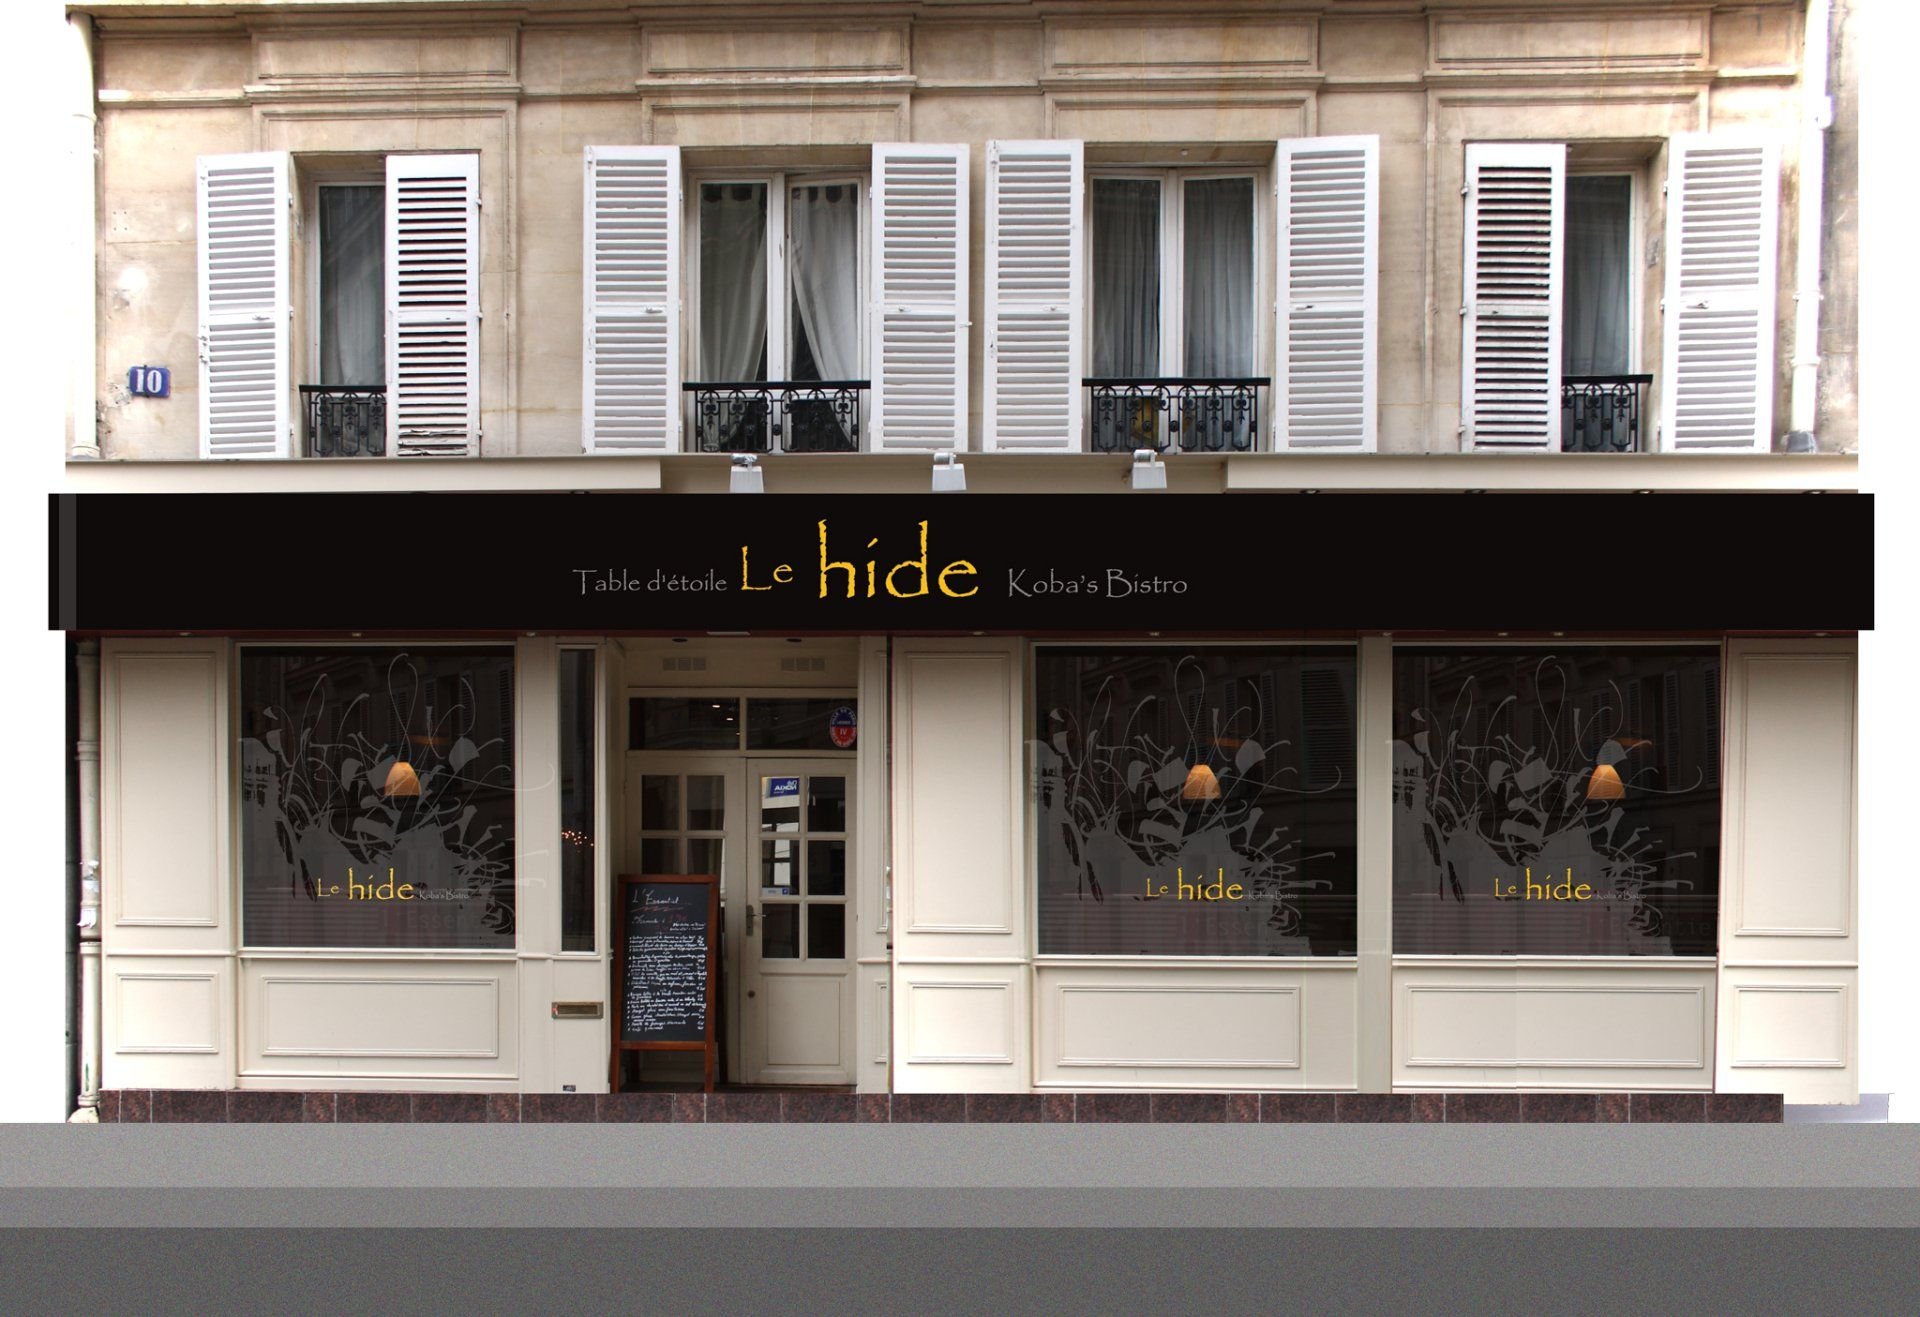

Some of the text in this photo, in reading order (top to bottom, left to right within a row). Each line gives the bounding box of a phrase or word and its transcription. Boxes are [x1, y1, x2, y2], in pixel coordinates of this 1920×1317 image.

[136, 369, 162, 393] 10
[573, 519, 1187, 598] Table d'étoile Le hide Koba's Bistro
[317, 878, 340, 897] Le
[348, 867, 415, 900] hide
[1146, 878, 1169, 897] Le
[1177, 867, 1244, 900] hide
[1495, 878, 1517, 897] Le
[1525, 867, 1592, 900] hide
